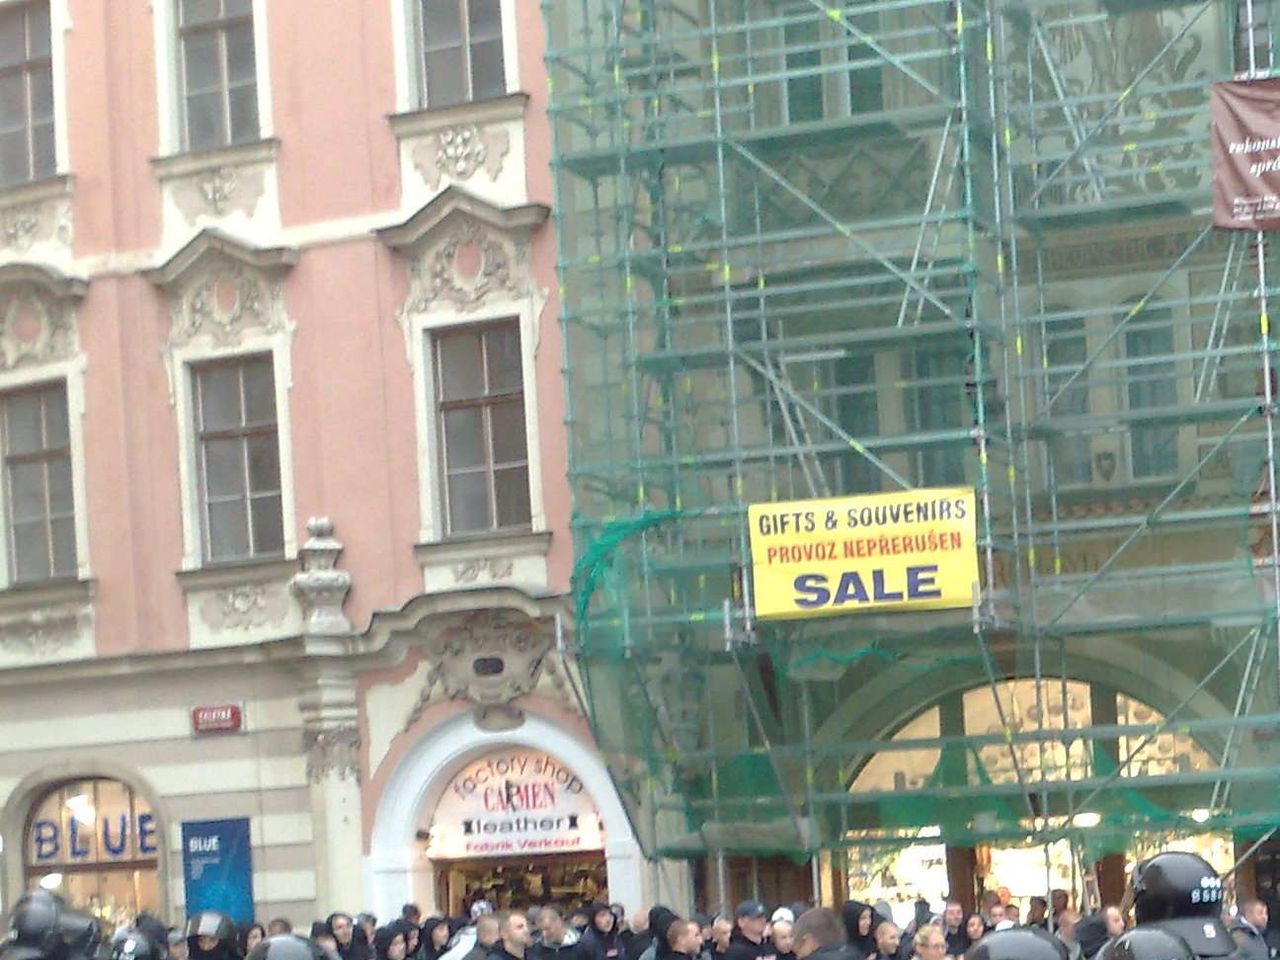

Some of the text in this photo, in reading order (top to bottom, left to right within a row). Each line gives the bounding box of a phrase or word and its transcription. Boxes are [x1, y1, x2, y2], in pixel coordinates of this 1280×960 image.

[758, 499, 966, 536] GIFTS & SOUVENIRS
[767, 529, 962, 565] PROVOZ NEPŘERUŠEN
[793, 565, 942, 609] SALE
[452, 755, 584, 800] factory shop
[33, 814, 157, 859] BLUE
[189, 835, 219, 852] BLUE
[477, 816, 566, 834] leather
